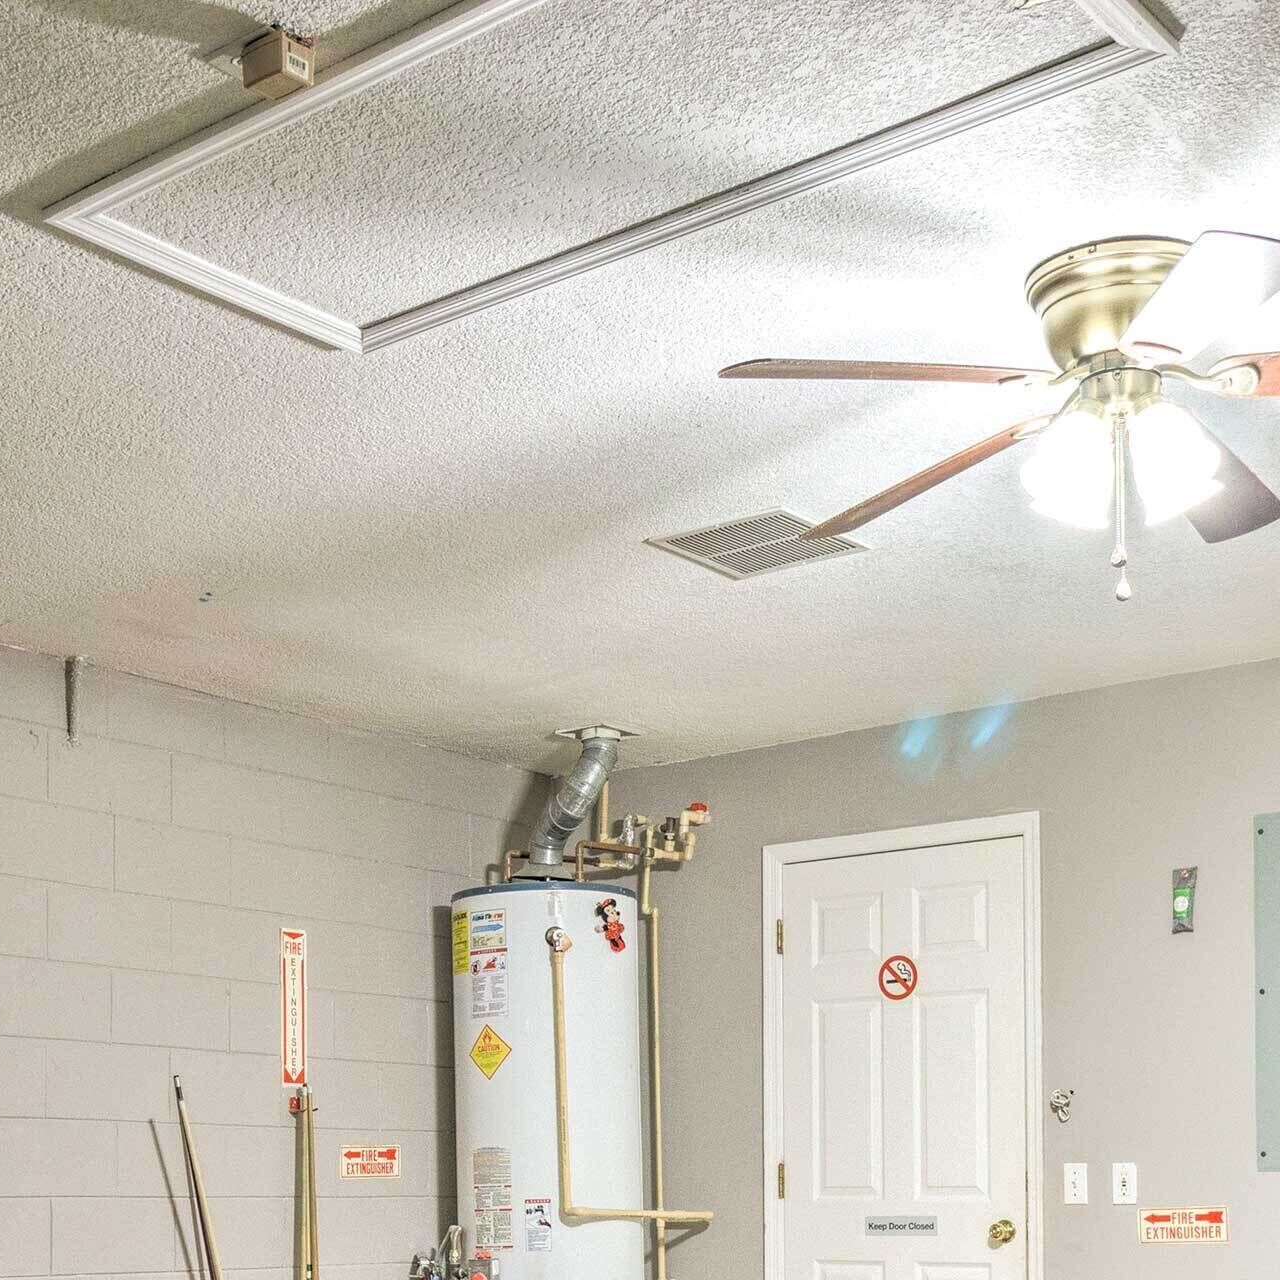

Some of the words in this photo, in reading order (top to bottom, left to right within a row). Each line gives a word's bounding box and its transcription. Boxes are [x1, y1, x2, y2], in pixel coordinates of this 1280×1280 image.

[284, 941, 302, 956] FIRE
[290, 957, 298, 1077] EXTINGUISHER
[361, 1149, 377, 1161] FIRE
[346, 1162, 394, 1175] EXTINGUISHER
[1171, 1212, 1194, 1225] FIRE
[868, 1222, 887, 1231] Keep
[888, 1222, 907, 1230] Door
[908, 1221, 934, 1230] Closed
[1146, 1226, 1222, 1240] EXTINGUISHER
